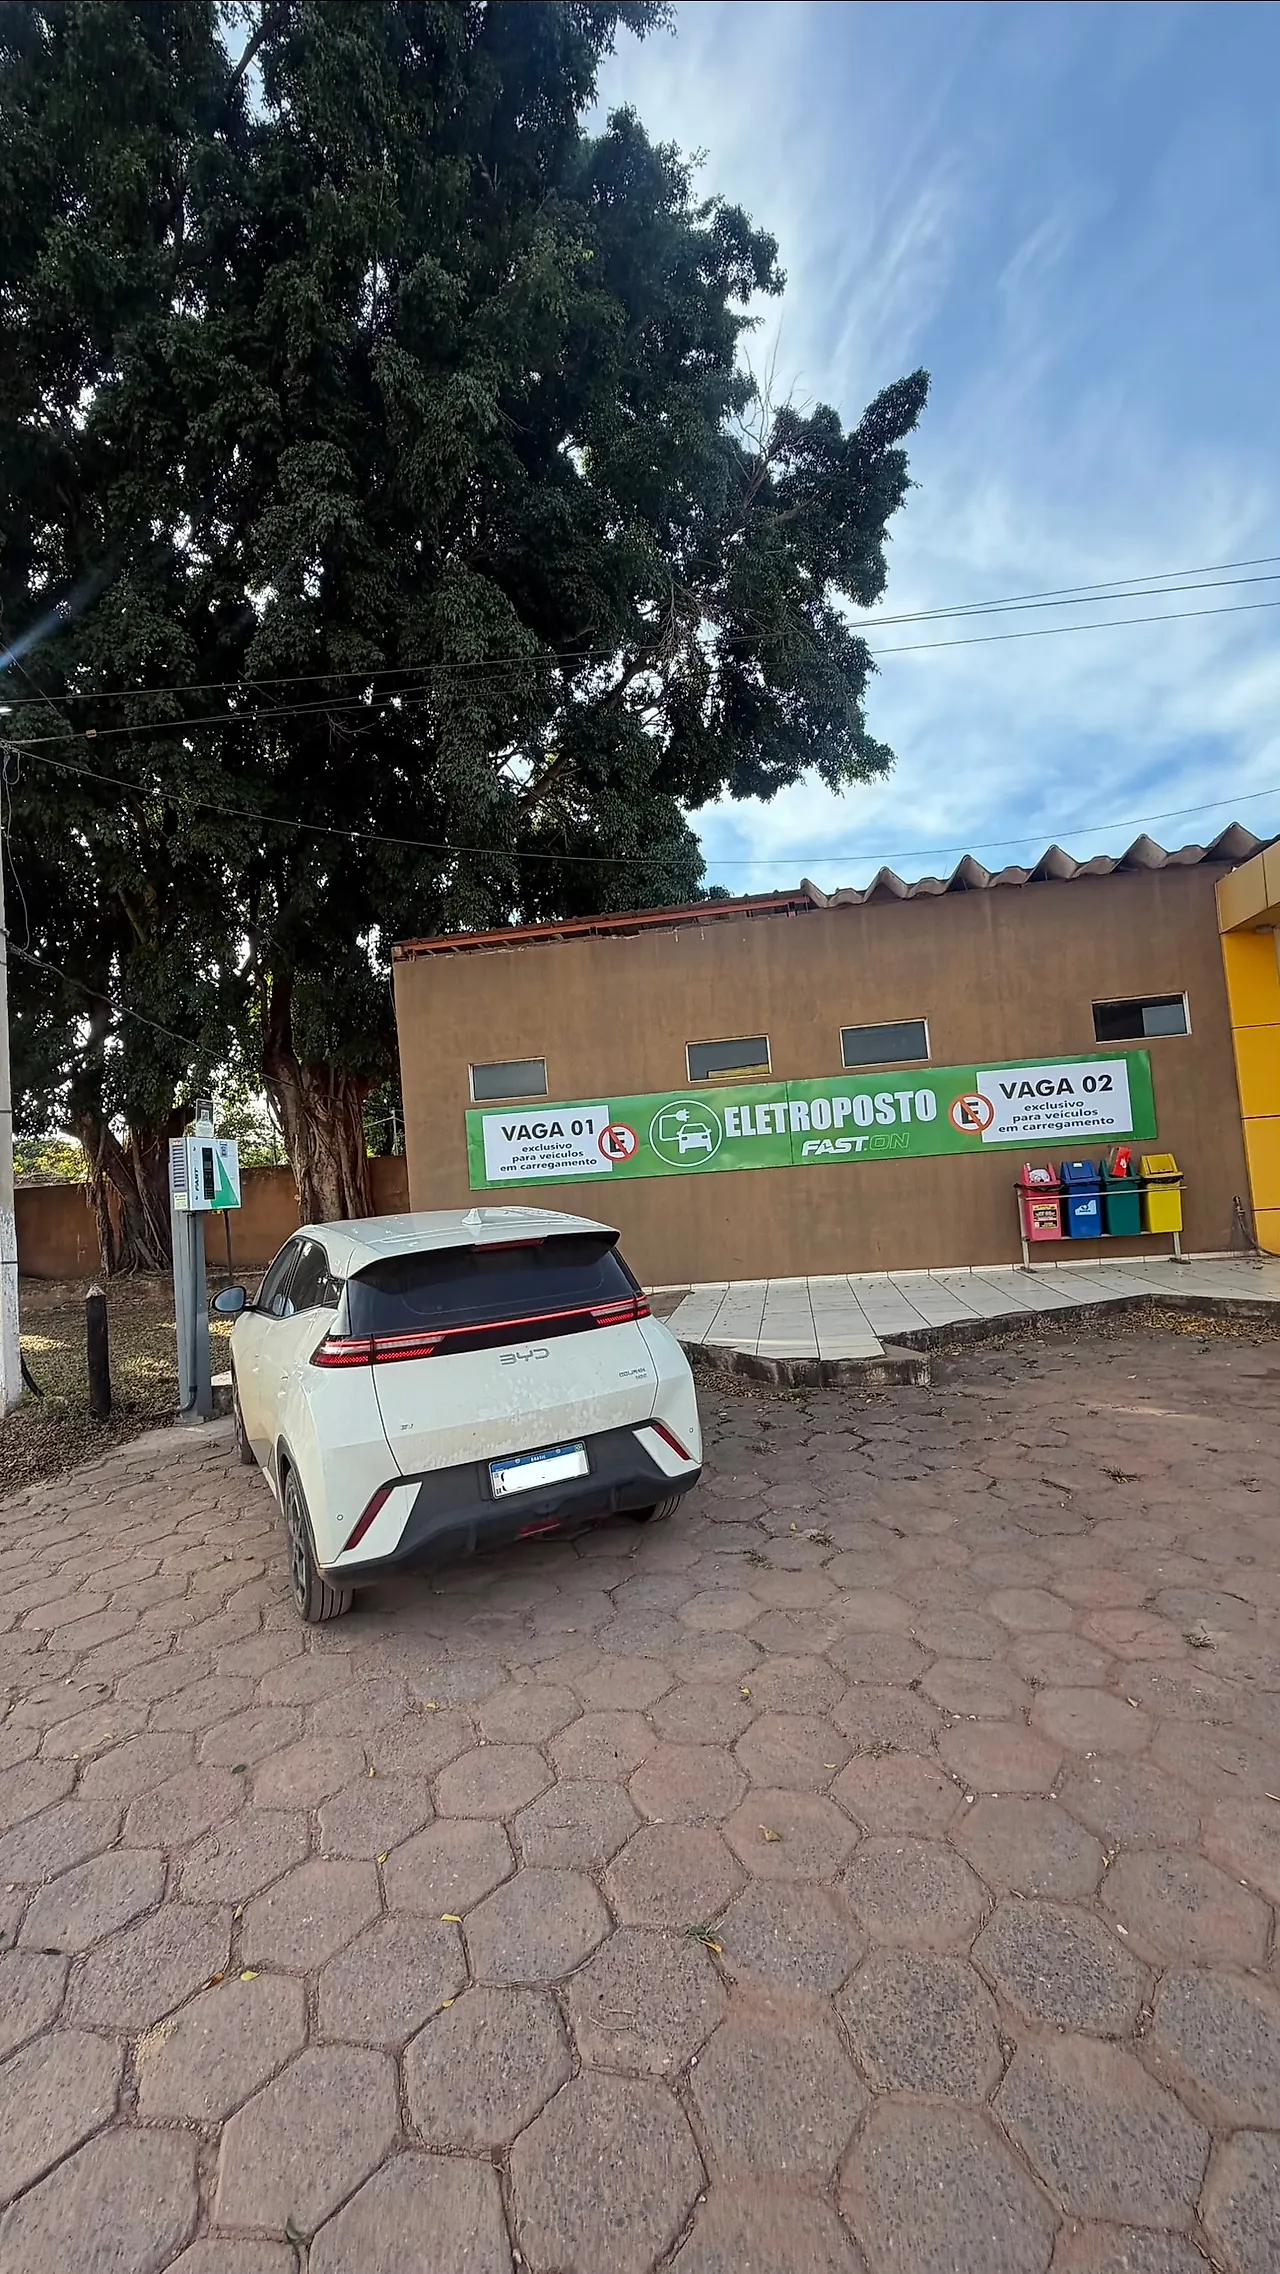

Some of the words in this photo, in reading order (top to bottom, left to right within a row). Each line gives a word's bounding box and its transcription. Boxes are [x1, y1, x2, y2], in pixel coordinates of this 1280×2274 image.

[998, 1077, 1075, 1100] VAGA
[1082, 1074, 1113, 1093] 02
[724, 1089, 937, 1138] ELETROPOSTO
[1024, 1099, 1084, 1112] exclusivo
[1012, 1112, 1041, 1124] para
[1044, 1108, 1099, 1120] veículos
[501, 1121, 564, 1141] VAGA
[571, 1119, 594, 1136] 01
[998, 1124, 1018, 1133] em
[1022, 1117, 1115, 1132] carregamento
[521, 1142, 573, 1153] exclusivo
[512, 1154, 536, 1164] para
[539, 1150, 584, 1160] veículos
[520, 1158, 597, 1170] carregamento
[499, 1348, 550, 1365] BYD
